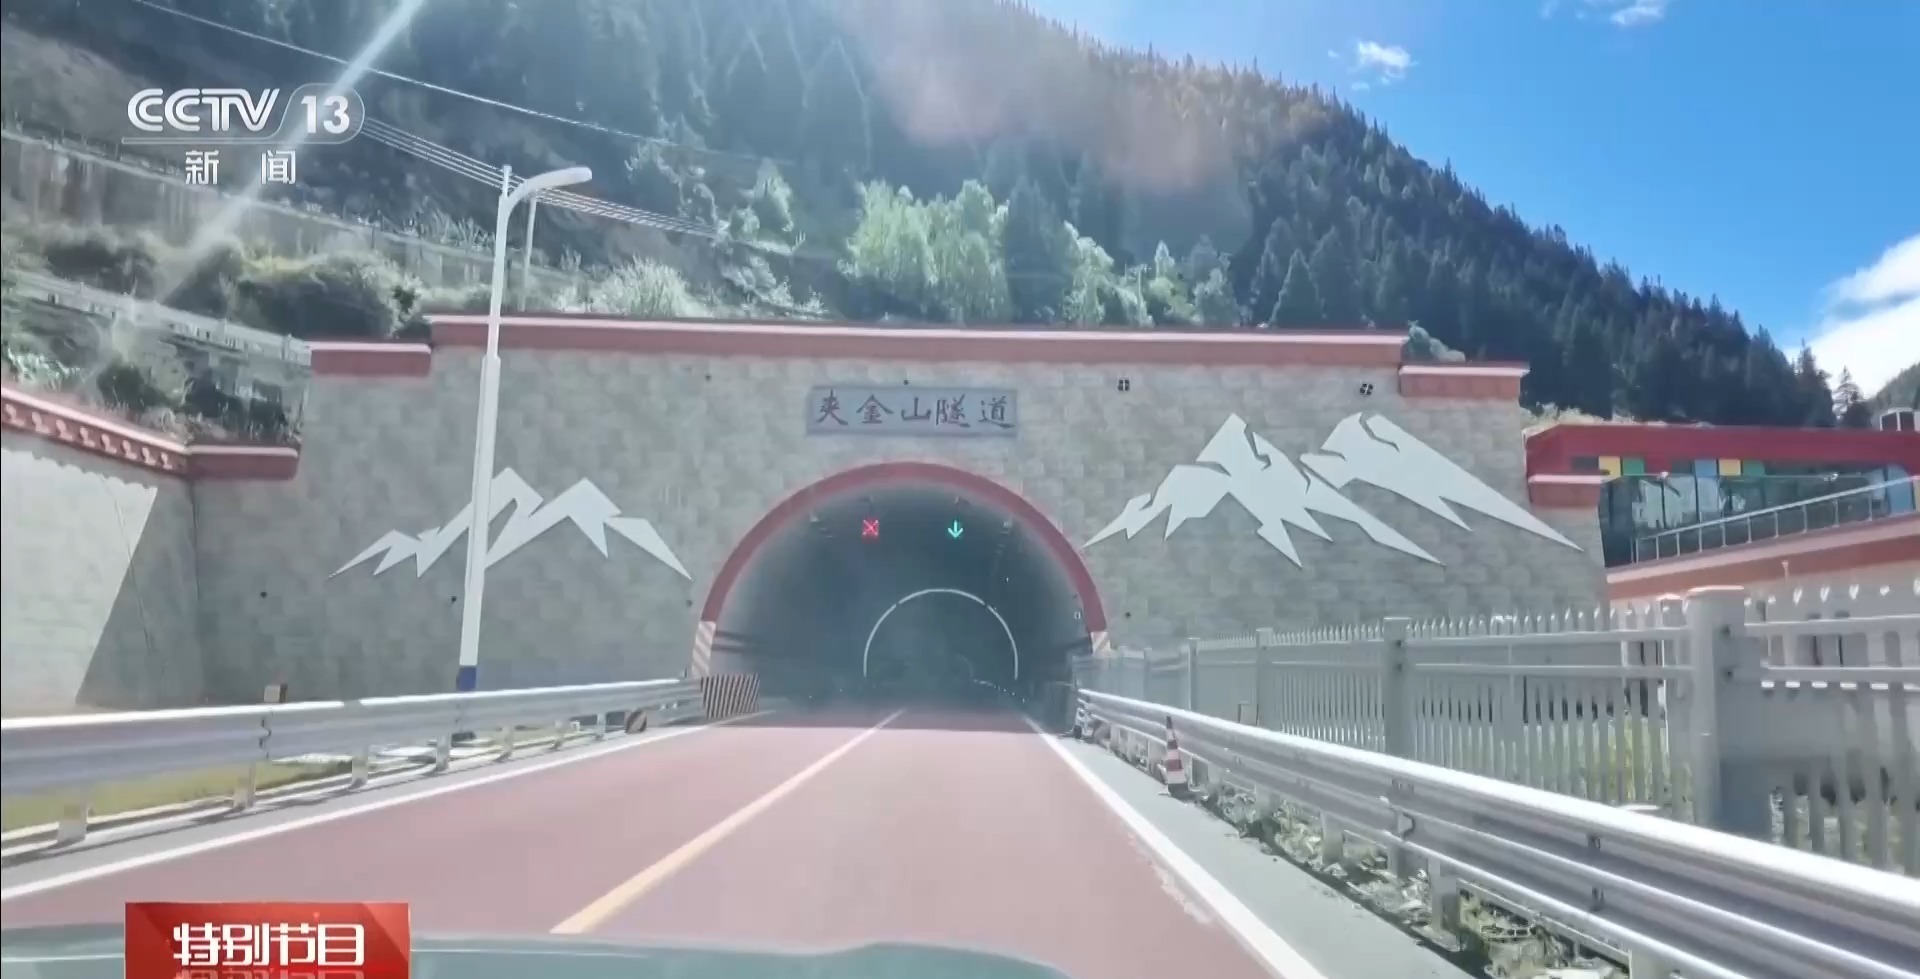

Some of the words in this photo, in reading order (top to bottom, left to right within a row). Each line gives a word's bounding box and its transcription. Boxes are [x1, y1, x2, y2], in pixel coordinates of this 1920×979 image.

[815, 388, 1016, 429] 夹金山隧道
